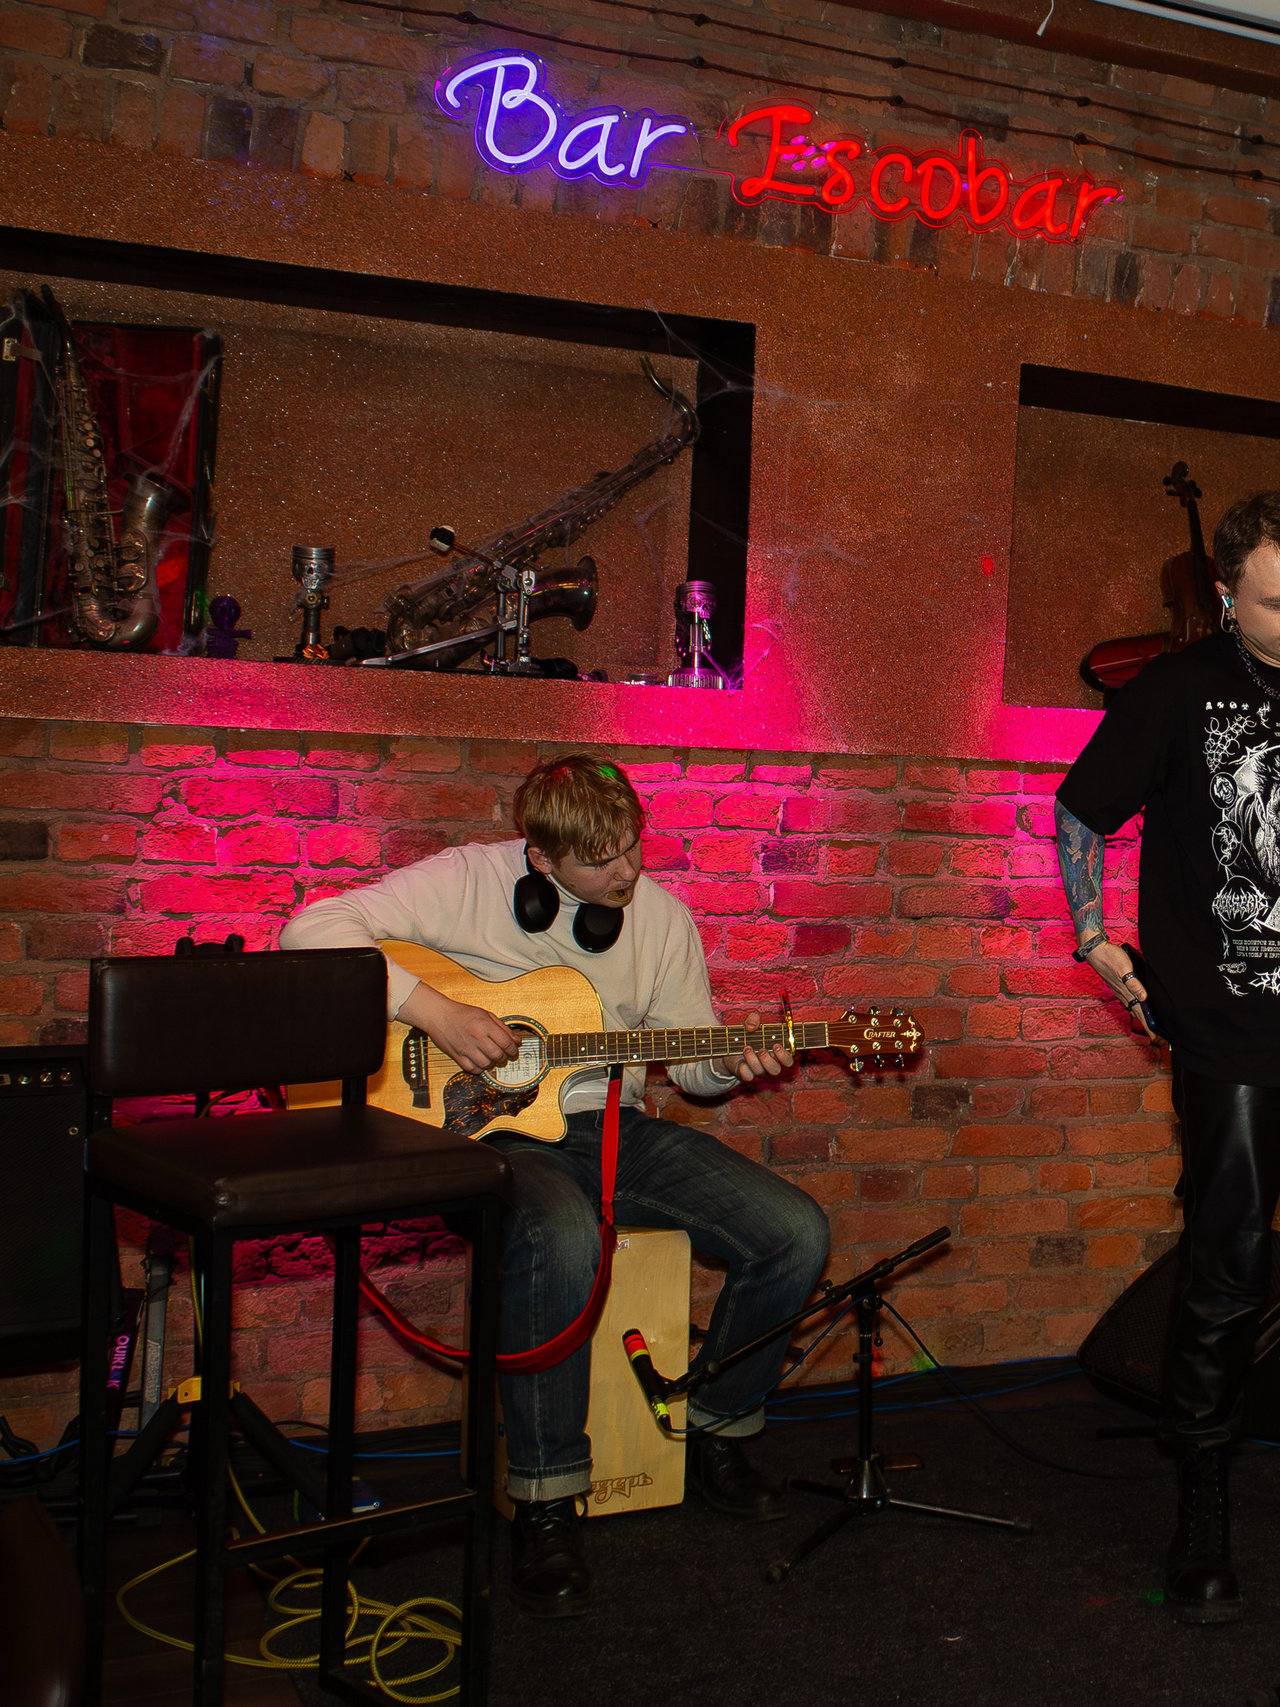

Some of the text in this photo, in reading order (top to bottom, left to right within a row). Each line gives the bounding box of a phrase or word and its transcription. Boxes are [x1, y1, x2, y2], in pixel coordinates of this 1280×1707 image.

[441, 52, 1121, 242] Bar Escobar
[863, 1028, 896, 1040] CRAFTER
